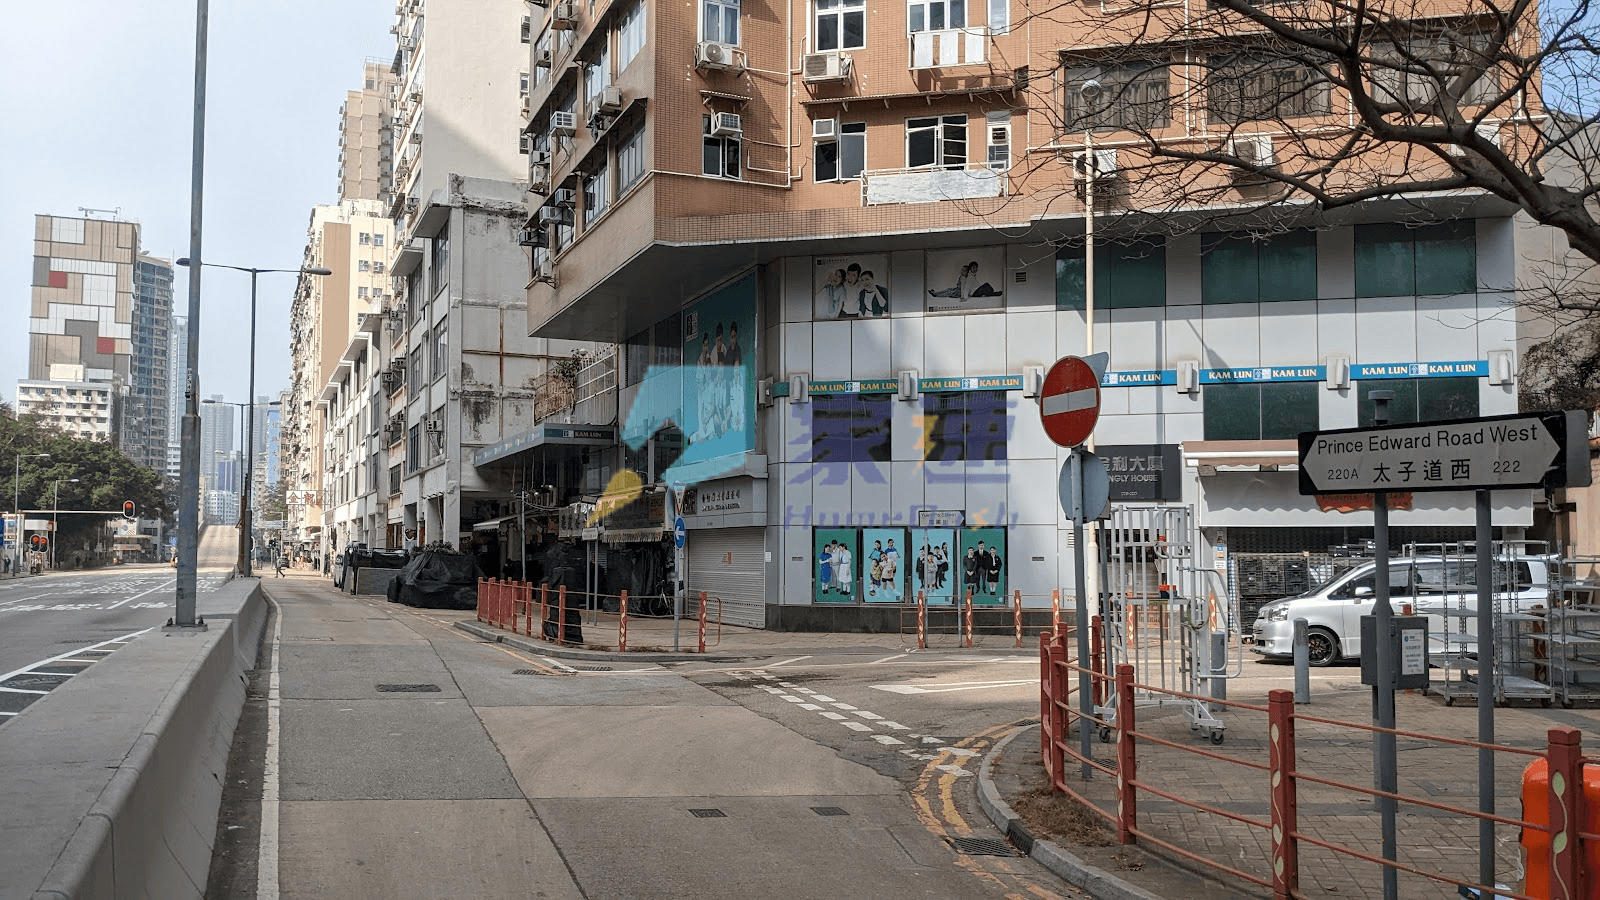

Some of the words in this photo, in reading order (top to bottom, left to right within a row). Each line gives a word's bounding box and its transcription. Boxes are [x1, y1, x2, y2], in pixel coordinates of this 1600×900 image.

[1272, 369, 1295, 377] KAM
[1297, 369, 1317, 377] LUN
[1362, 366, 1385, 375] KAM
[1388, 366, 1408, 374] LUN
[1429, 365, 1453, 373] KAM
[1456, 364, 1476, 372] LUN
[1119, 374, 1141, 382] KAM
[1143, 373, 1161, 381] LUN
[1208, 371, 1231, 379] KAM
[1233, 370, 1252, 379] LUN
[860, 383, 880, 391] KAM
[882, 382, 898, 390] LUN
[922, 381, 942, 389] KAM
[979, 379, 1000, 387] KAM
[808, 384, 827, 392] KAM
[1317, 439, 1363, 455] Prince
[1369, 432, 1431, 451] Edward
[1437, 429, 1484, 446] Road
[1489, 424, 1538, 443] West
[1372, 458, 1471, 483] 太子道西
[1493, 460, 1521, 473] 222
[1131, 474, 1158, 482] HOUSE
[1327, 468, 1359, 480] 220A
